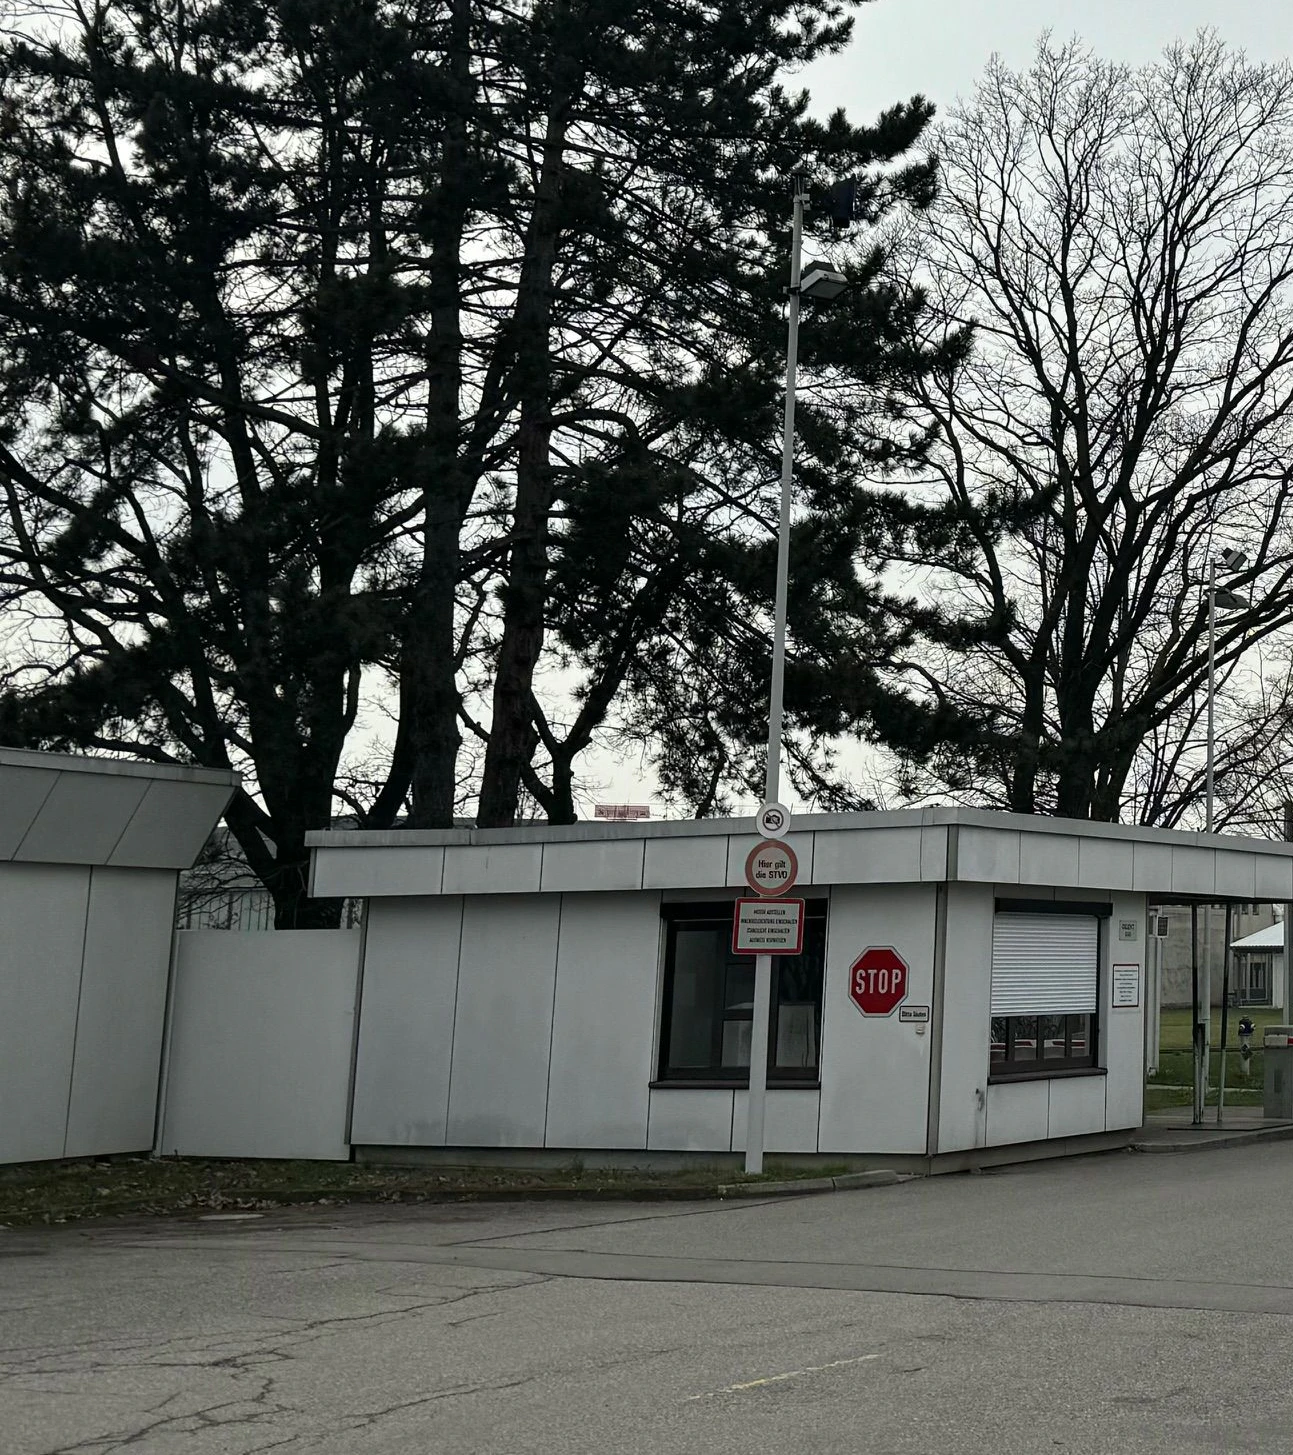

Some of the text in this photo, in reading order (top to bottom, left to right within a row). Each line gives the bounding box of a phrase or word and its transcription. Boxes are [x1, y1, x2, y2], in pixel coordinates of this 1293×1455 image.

[758, 859, 786, 870] Hier gilt
[755, 871, 767, 879] die
[855, 969, 902, 994] STOP
